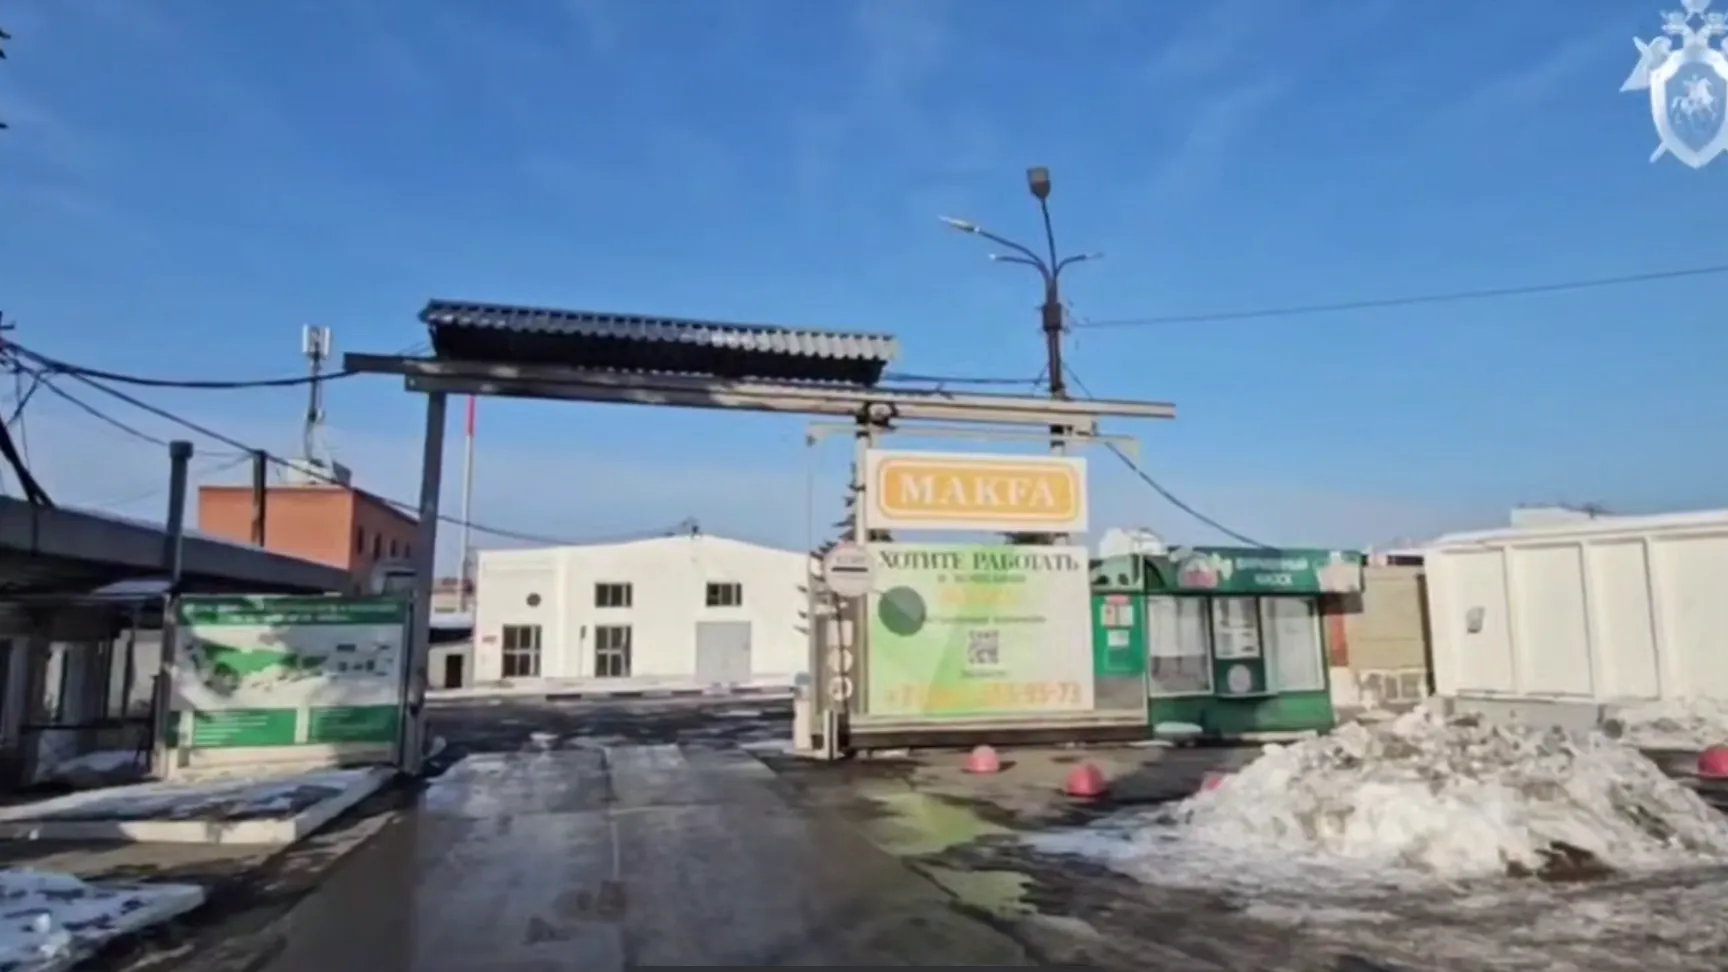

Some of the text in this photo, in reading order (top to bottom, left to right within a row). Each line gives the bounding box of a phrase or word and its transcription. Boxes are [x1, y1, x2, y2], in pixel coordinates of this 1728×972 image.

[899, 474, 1056, 508] MAKFA
[879, 550, 965, 571] ХОТИТЕ
[973, 551, 1080, 572] РАБОТАТЬ
